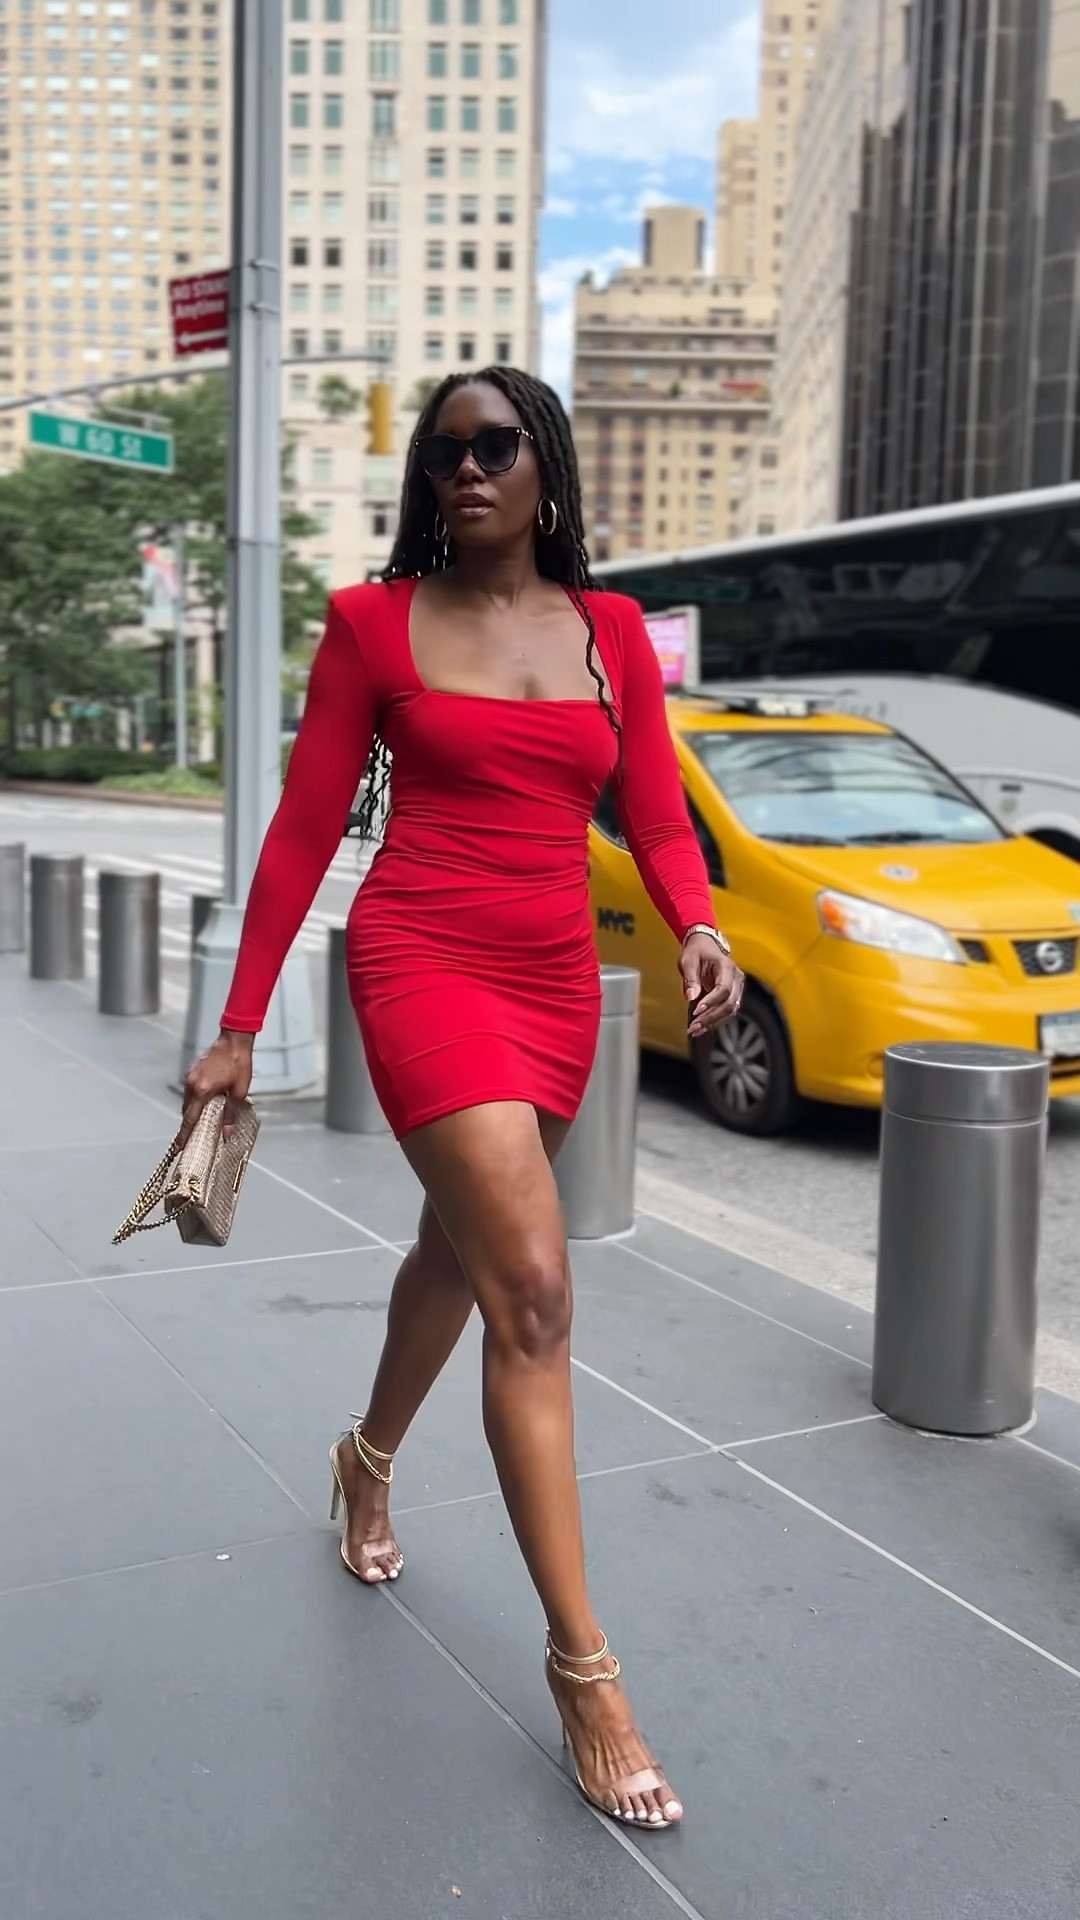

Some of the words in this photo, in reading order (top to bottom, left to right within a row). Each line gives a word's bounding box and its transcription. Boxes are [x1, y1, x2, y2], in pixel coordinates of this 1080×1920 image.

[175, 300, 225, 319] Anytime
[59, 423, 80, 447] W
[85, 427, 116, 453] 60
[597, 906, 636, 936] NYC
